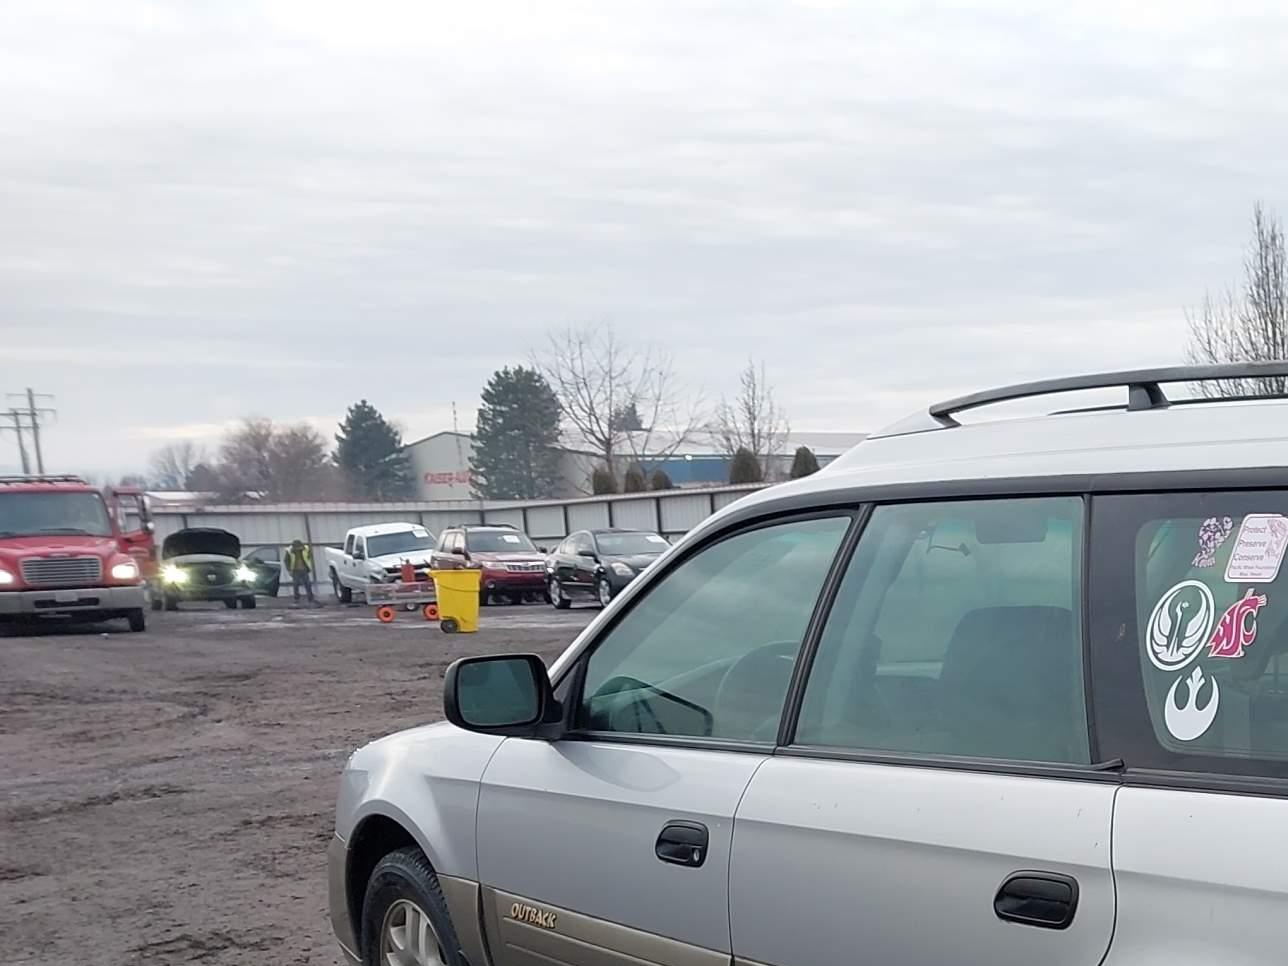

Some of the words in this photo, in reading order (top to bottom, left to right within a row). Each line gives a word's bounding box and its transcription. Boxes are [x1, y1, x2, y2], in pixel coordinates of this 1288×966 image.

[1239, 539, 1267, 548] Preserve
[1233, 553, 1264, 561] Conserve
[511, 902, 557, 928] OUTBACK
